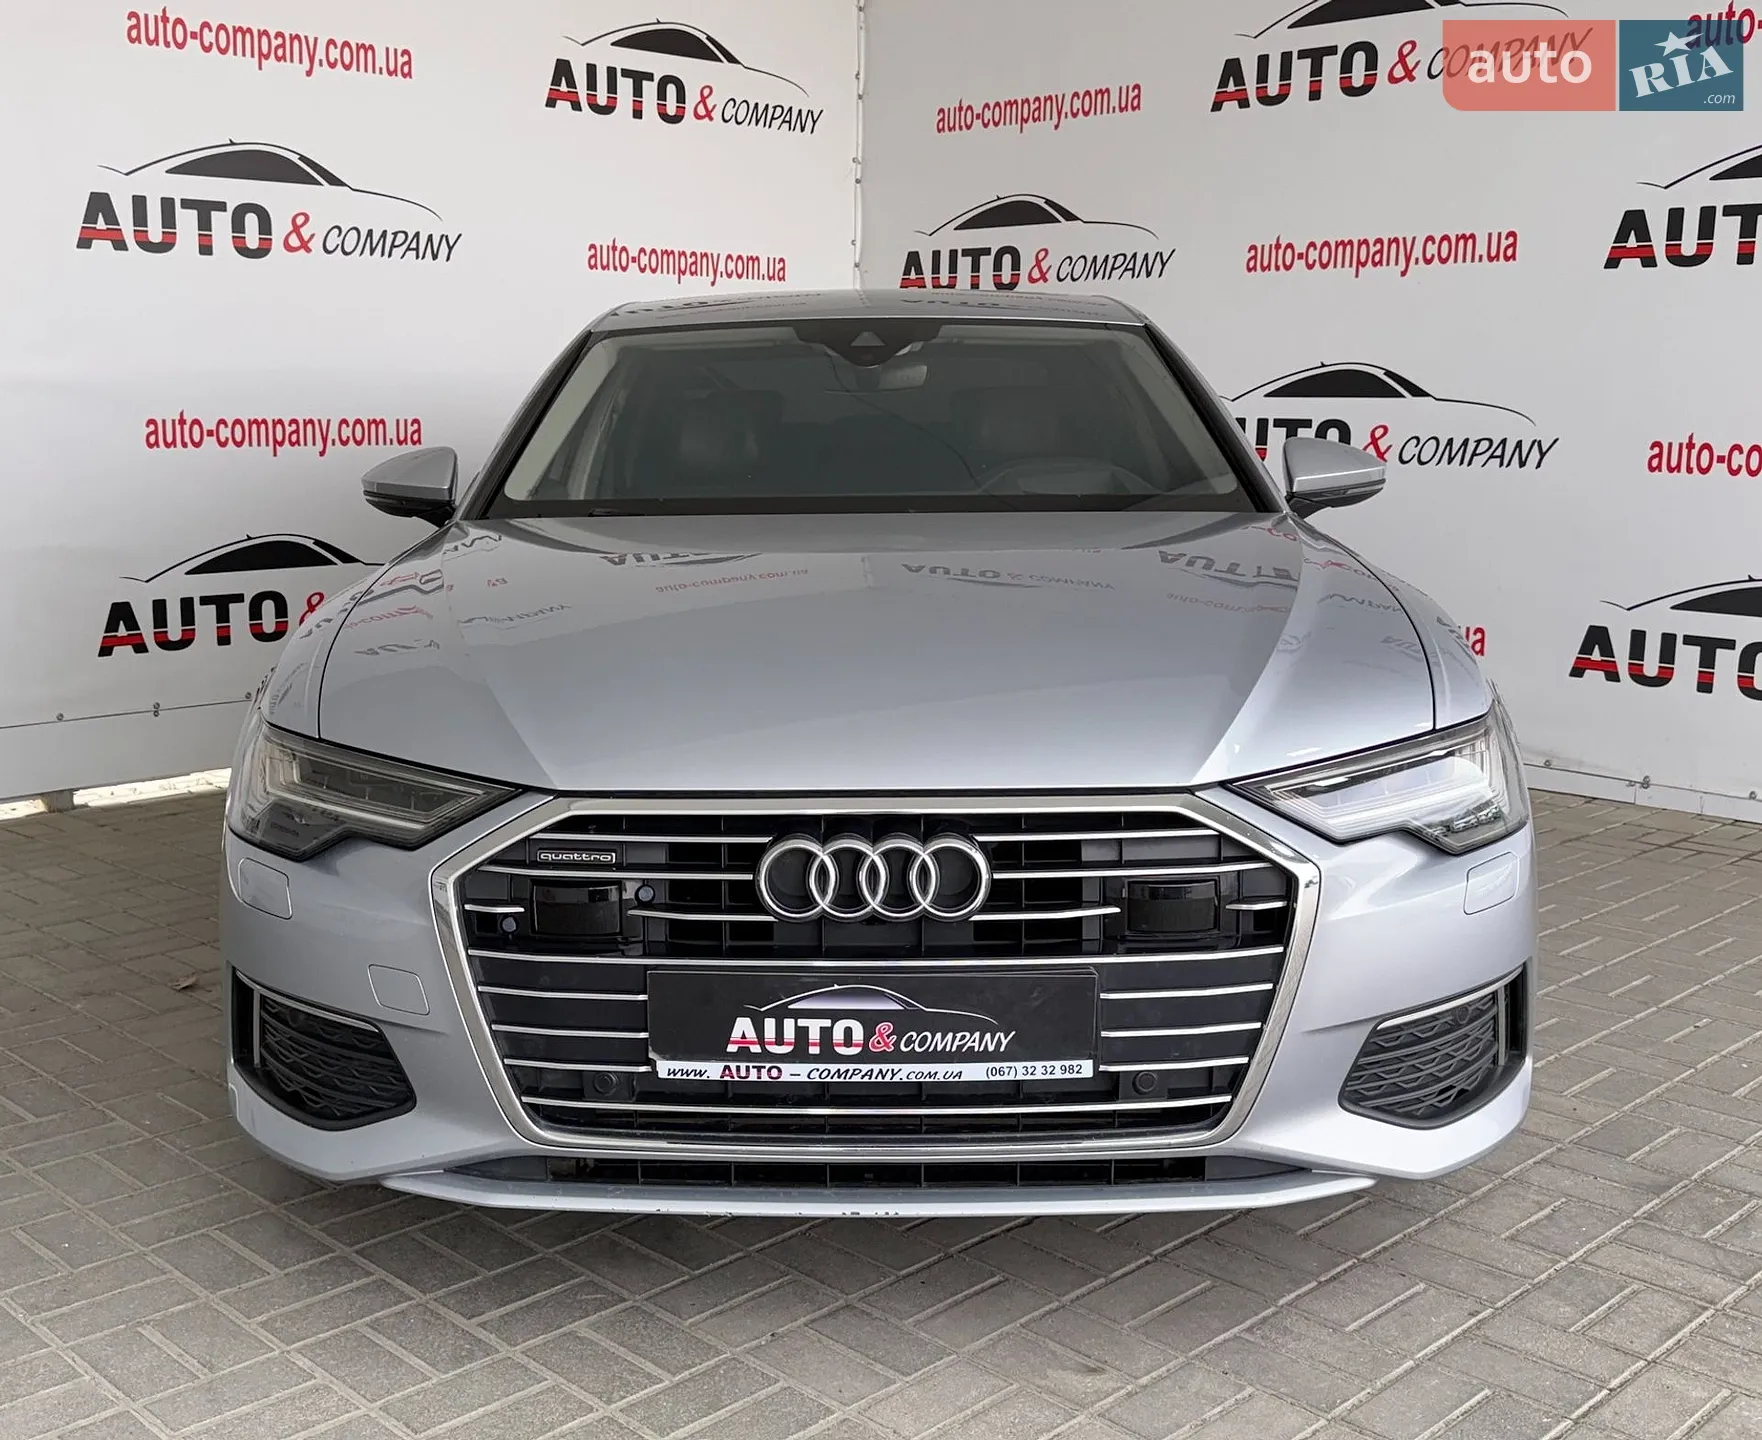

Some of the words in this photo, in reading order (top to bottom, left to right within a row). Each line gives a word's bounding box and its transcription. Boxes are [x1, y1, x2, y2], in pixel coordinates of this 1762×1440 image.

[126, 7, 414, 79] auto-company.com.ua
[545, 57, 687, 125] AUTO
[692, 84, 717, 122] &
[721, 97, 824, 135] COMPANY
[1211, 40, 1379, 112] AUTO
[1387, 40, 1420, 85] &
[936, 82, 1142, 134] auto-company.com.ua
[76, 191, 273, 259] AUTO
[282, 211, 316, 254] &
[322, 224, 463, 263] COMPANY
[587, 239, 786, 286] auto-company.com.ua
[899, 245, 1021, 290] AUTO
[1027, 247, 1052, 285] &
[1056, 248, 1177, 283] COMPANY
[1245, 229, 1519, 278] auto-company.com.ua
[144, 410, 423, 456] auto-company.com.ua
[1363, 424, 1393, 462] &
[1398, 435, 1560, 470] COMPANY
[98, 590, 289, 658] AUTO
[540, 852, 611, 862] quattro
[726, 1017, 864, 1056] AUTO
[868, 1022, 896, 1052] &
[900, 1030, 1015, 1053] COMPANY
[719, 1065, 783, 1080] AUTO
[985, 1065, 1018, 1079] (067)
[1021, 1065, 1037, 1076] 32
[1040, 1064, 1056, 1076] 32
[1059, 1063, 1083, 1075] 982
